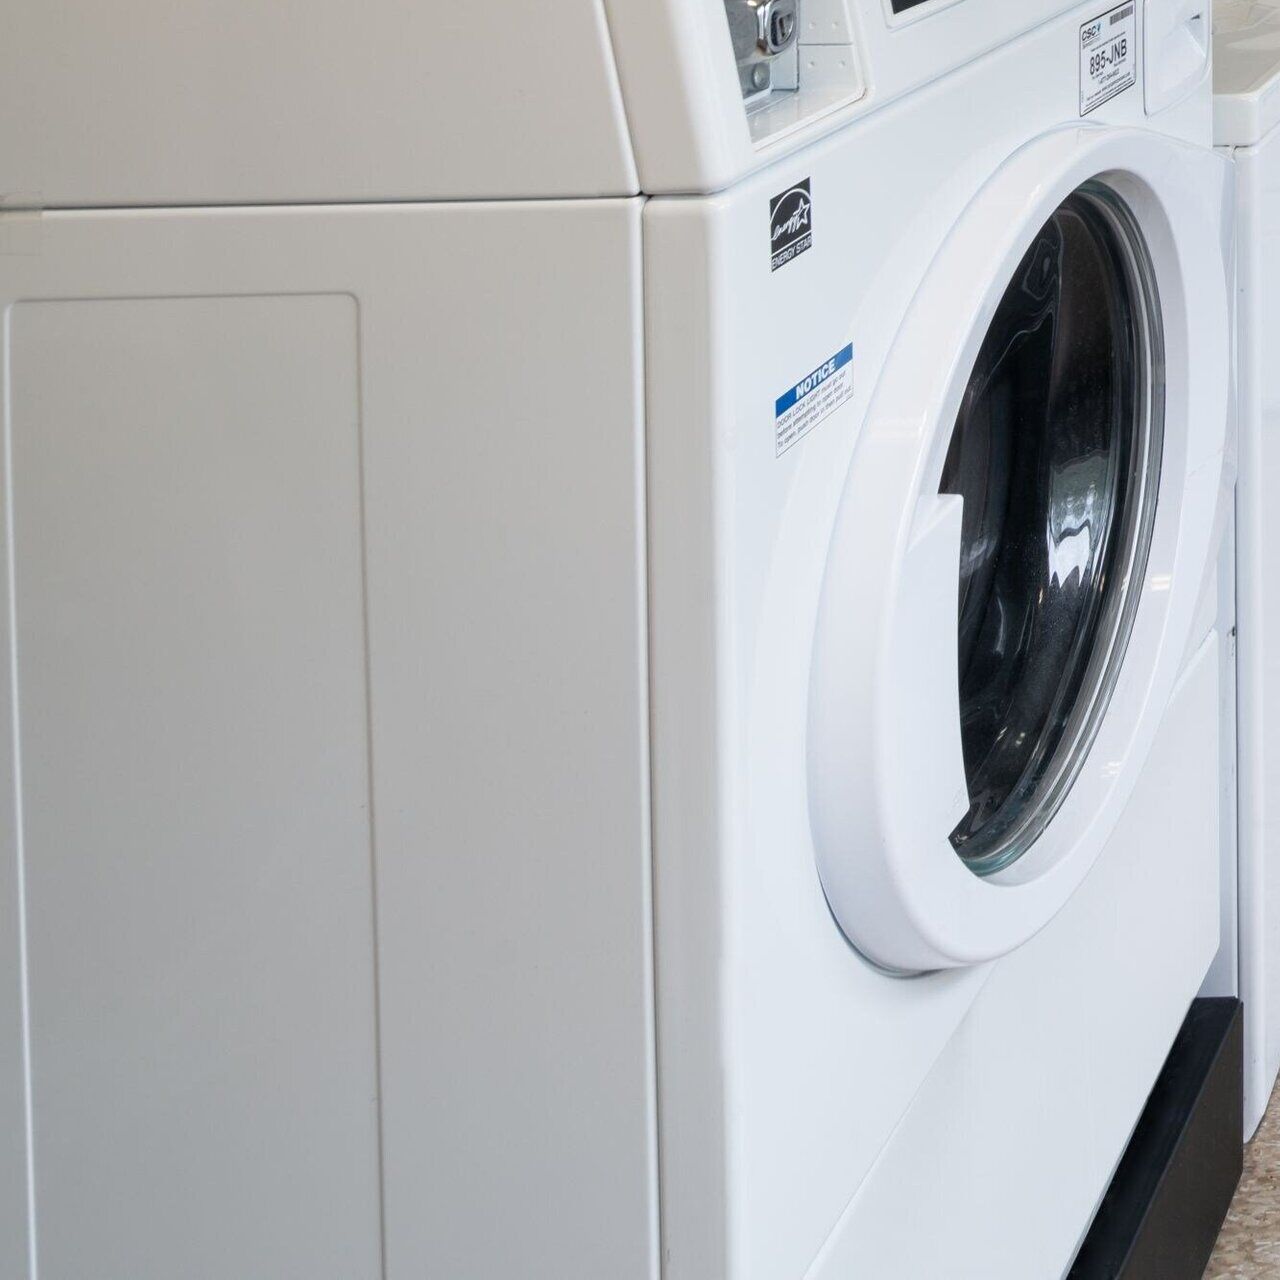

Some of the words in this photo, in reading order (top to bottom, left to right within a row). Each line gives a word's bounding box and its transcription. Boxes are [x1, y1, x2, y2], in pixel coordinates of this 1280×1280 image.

[1082, 25, 1097, 41] CSC
[1089, 38, 1127, 76] 895-JNB
[771, 245, 796, 269] ENERGY
[796, 234, 812, 254] STAR
[795, 358, 836, 400] NOTICE
